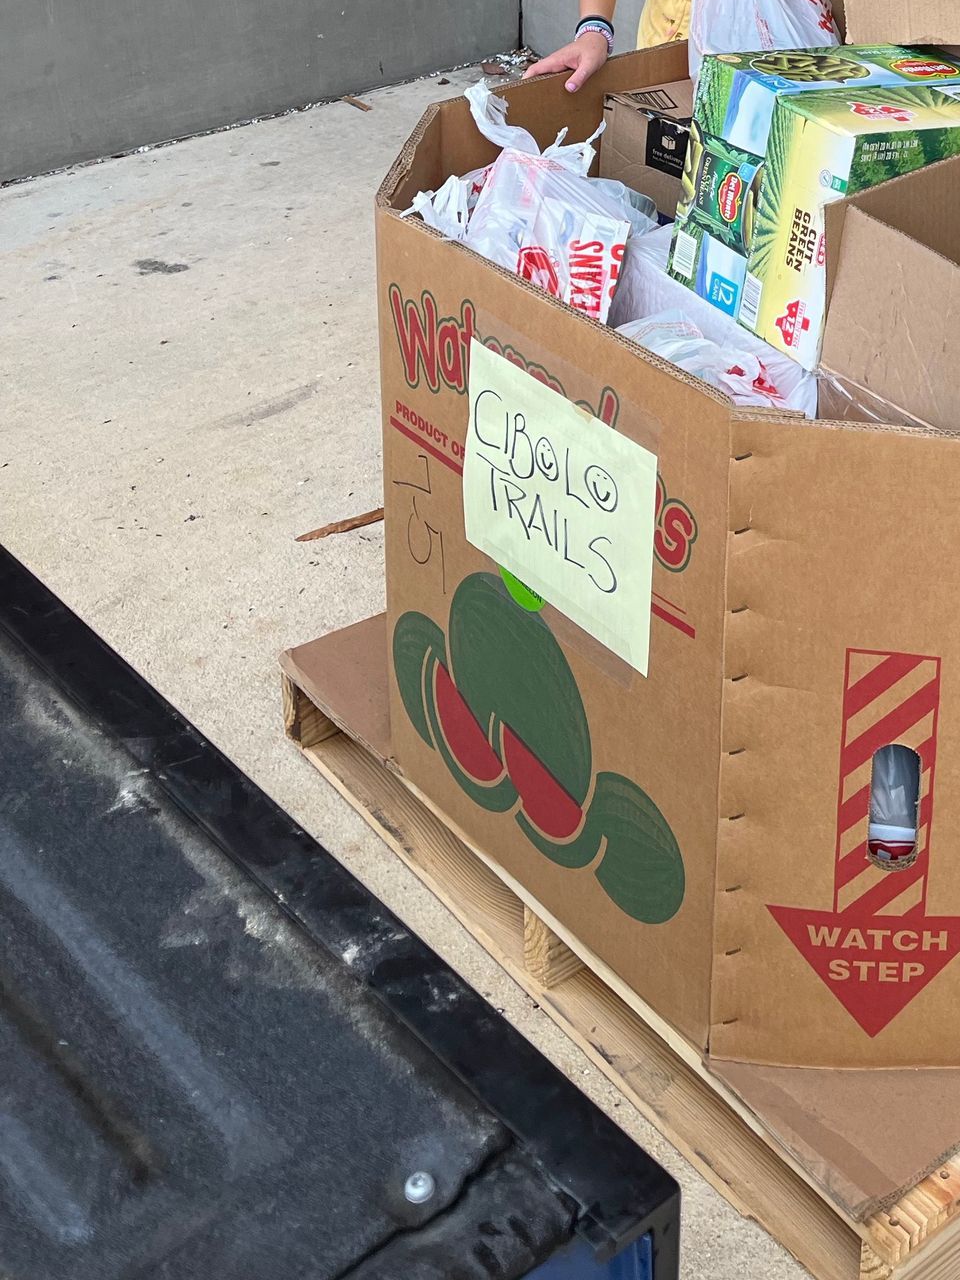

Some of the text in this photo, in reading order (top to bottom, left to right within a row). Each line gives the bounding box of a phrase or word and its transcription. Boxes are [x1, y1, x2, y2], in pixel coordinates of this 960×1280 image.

[652, 148, 663, 157] free
[663, 153, 684, 166] delivery
[698, 156, 712, 206] GREEN BEANS
[703, 174, 711, 192] CUT
[724, 175, 738, 219] Del Monte
[785, 207, 803, 267] BEANS
[793, 211, 811, 273] GREEN
[804, 228, 817, 265] CUT
[569, 240, 604, 316] EXANS
[712, 278, 720, 301] CANS
[717, 281, 735, 306] 12
[786, 315, 796, 334] 12
[395, 400, 449, 449] PRODUCT
[474, 389, 619, 513] CIBOLO
[476, 452, 618, 594] TRAILS
[806, 924, 950, 952] WATCH
[828, 958, 927, 984] STEP
